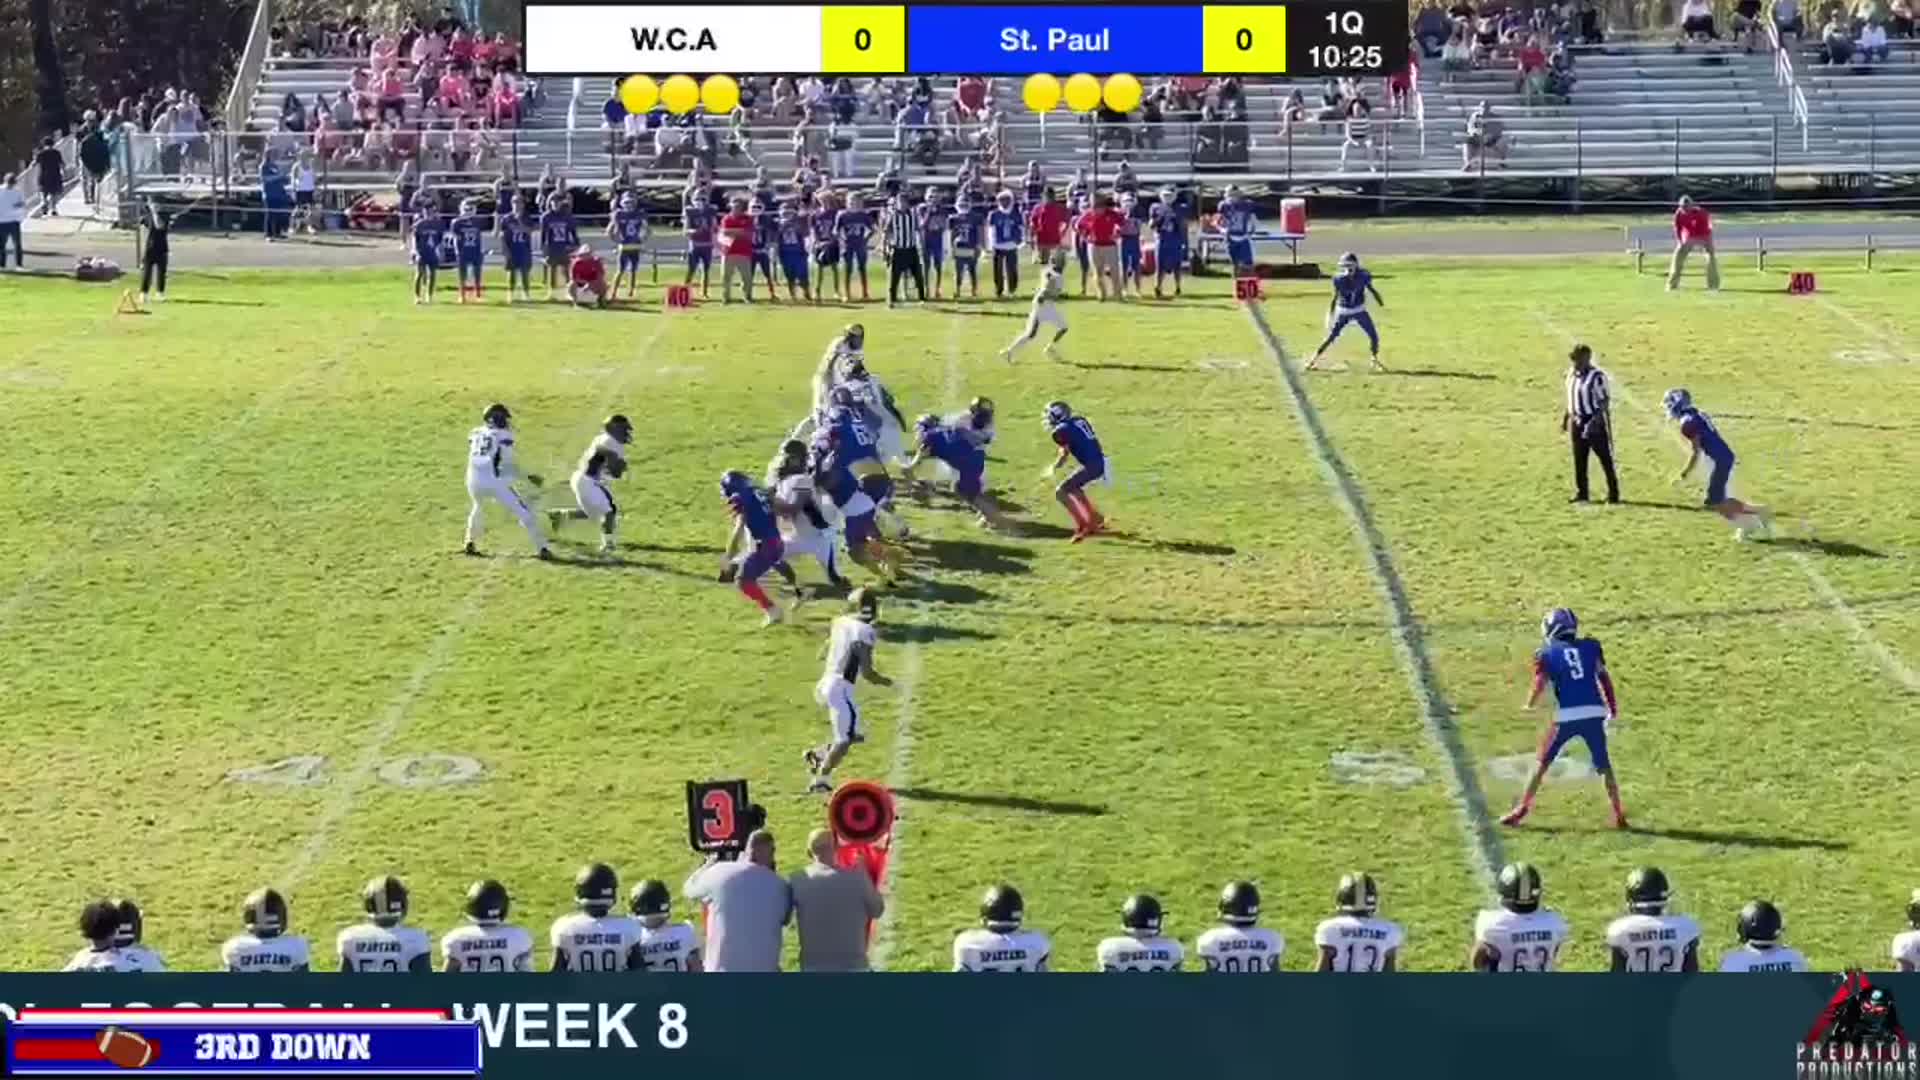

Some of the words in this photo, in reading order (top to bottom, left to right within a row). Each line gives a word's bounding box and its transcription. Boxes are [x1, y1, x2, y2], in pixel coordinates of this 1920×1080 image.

[1236, 280, 1258, 299] 50
[1793, 273, 1814, 294] 40
[1563, 647, 1584, 680] 9
[703, 789, 735, 839] 3
